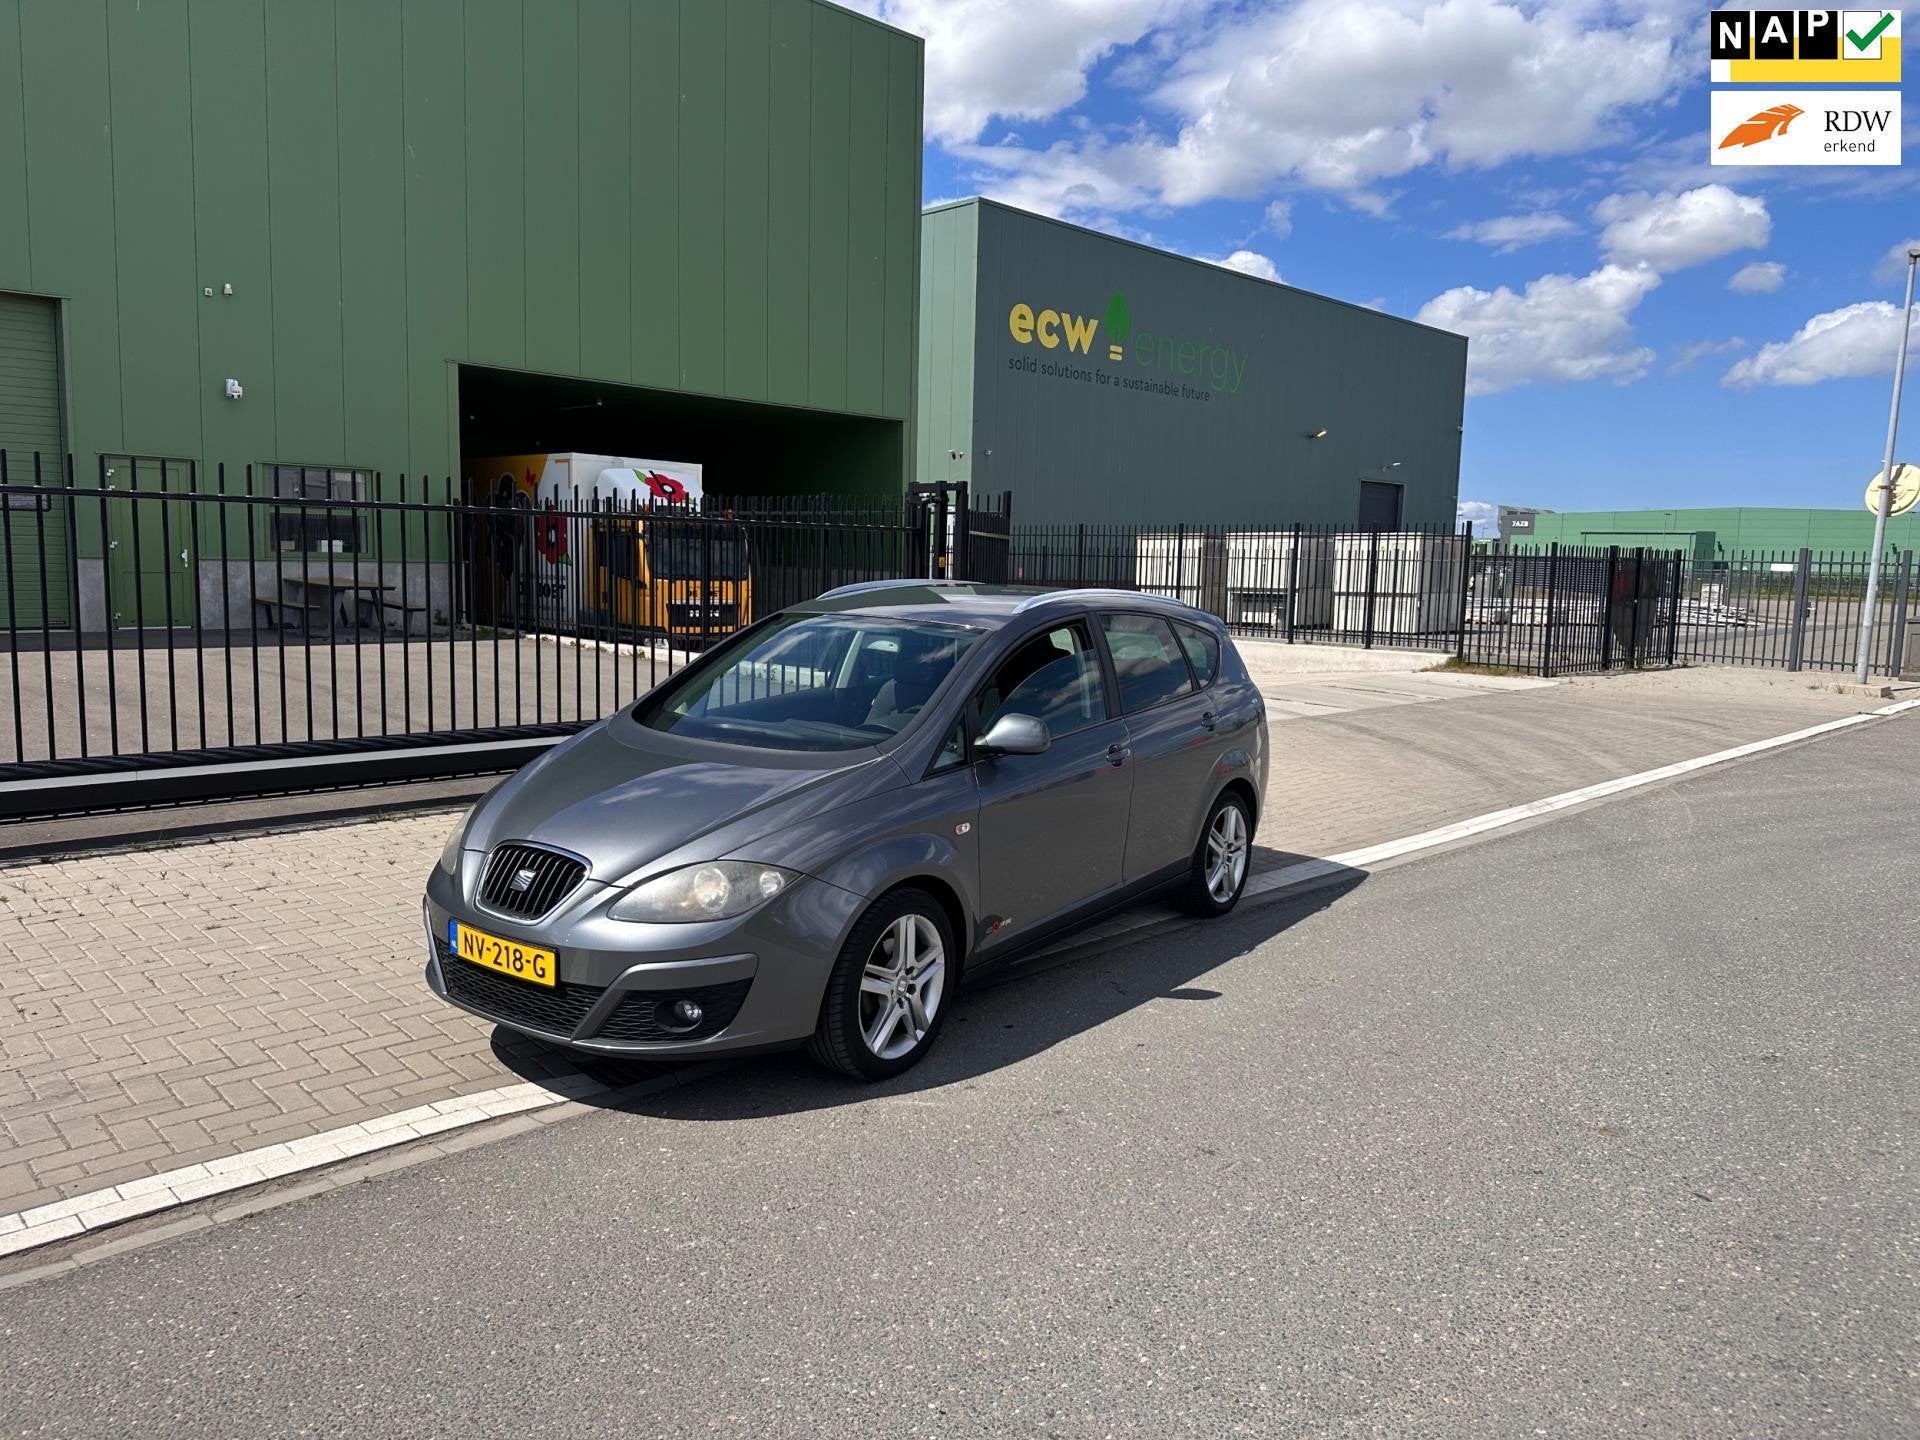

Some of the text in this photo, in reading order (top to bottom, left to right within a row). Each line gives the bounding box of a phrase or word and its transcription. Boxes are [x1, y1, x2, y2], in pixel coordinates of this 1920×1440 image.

[1009, 303, 1249, 393] ecw energy
[1008, 355, 1210, 402] solid solutions for a sustainable future
[464, 931, 546, 978] NV-218-G
